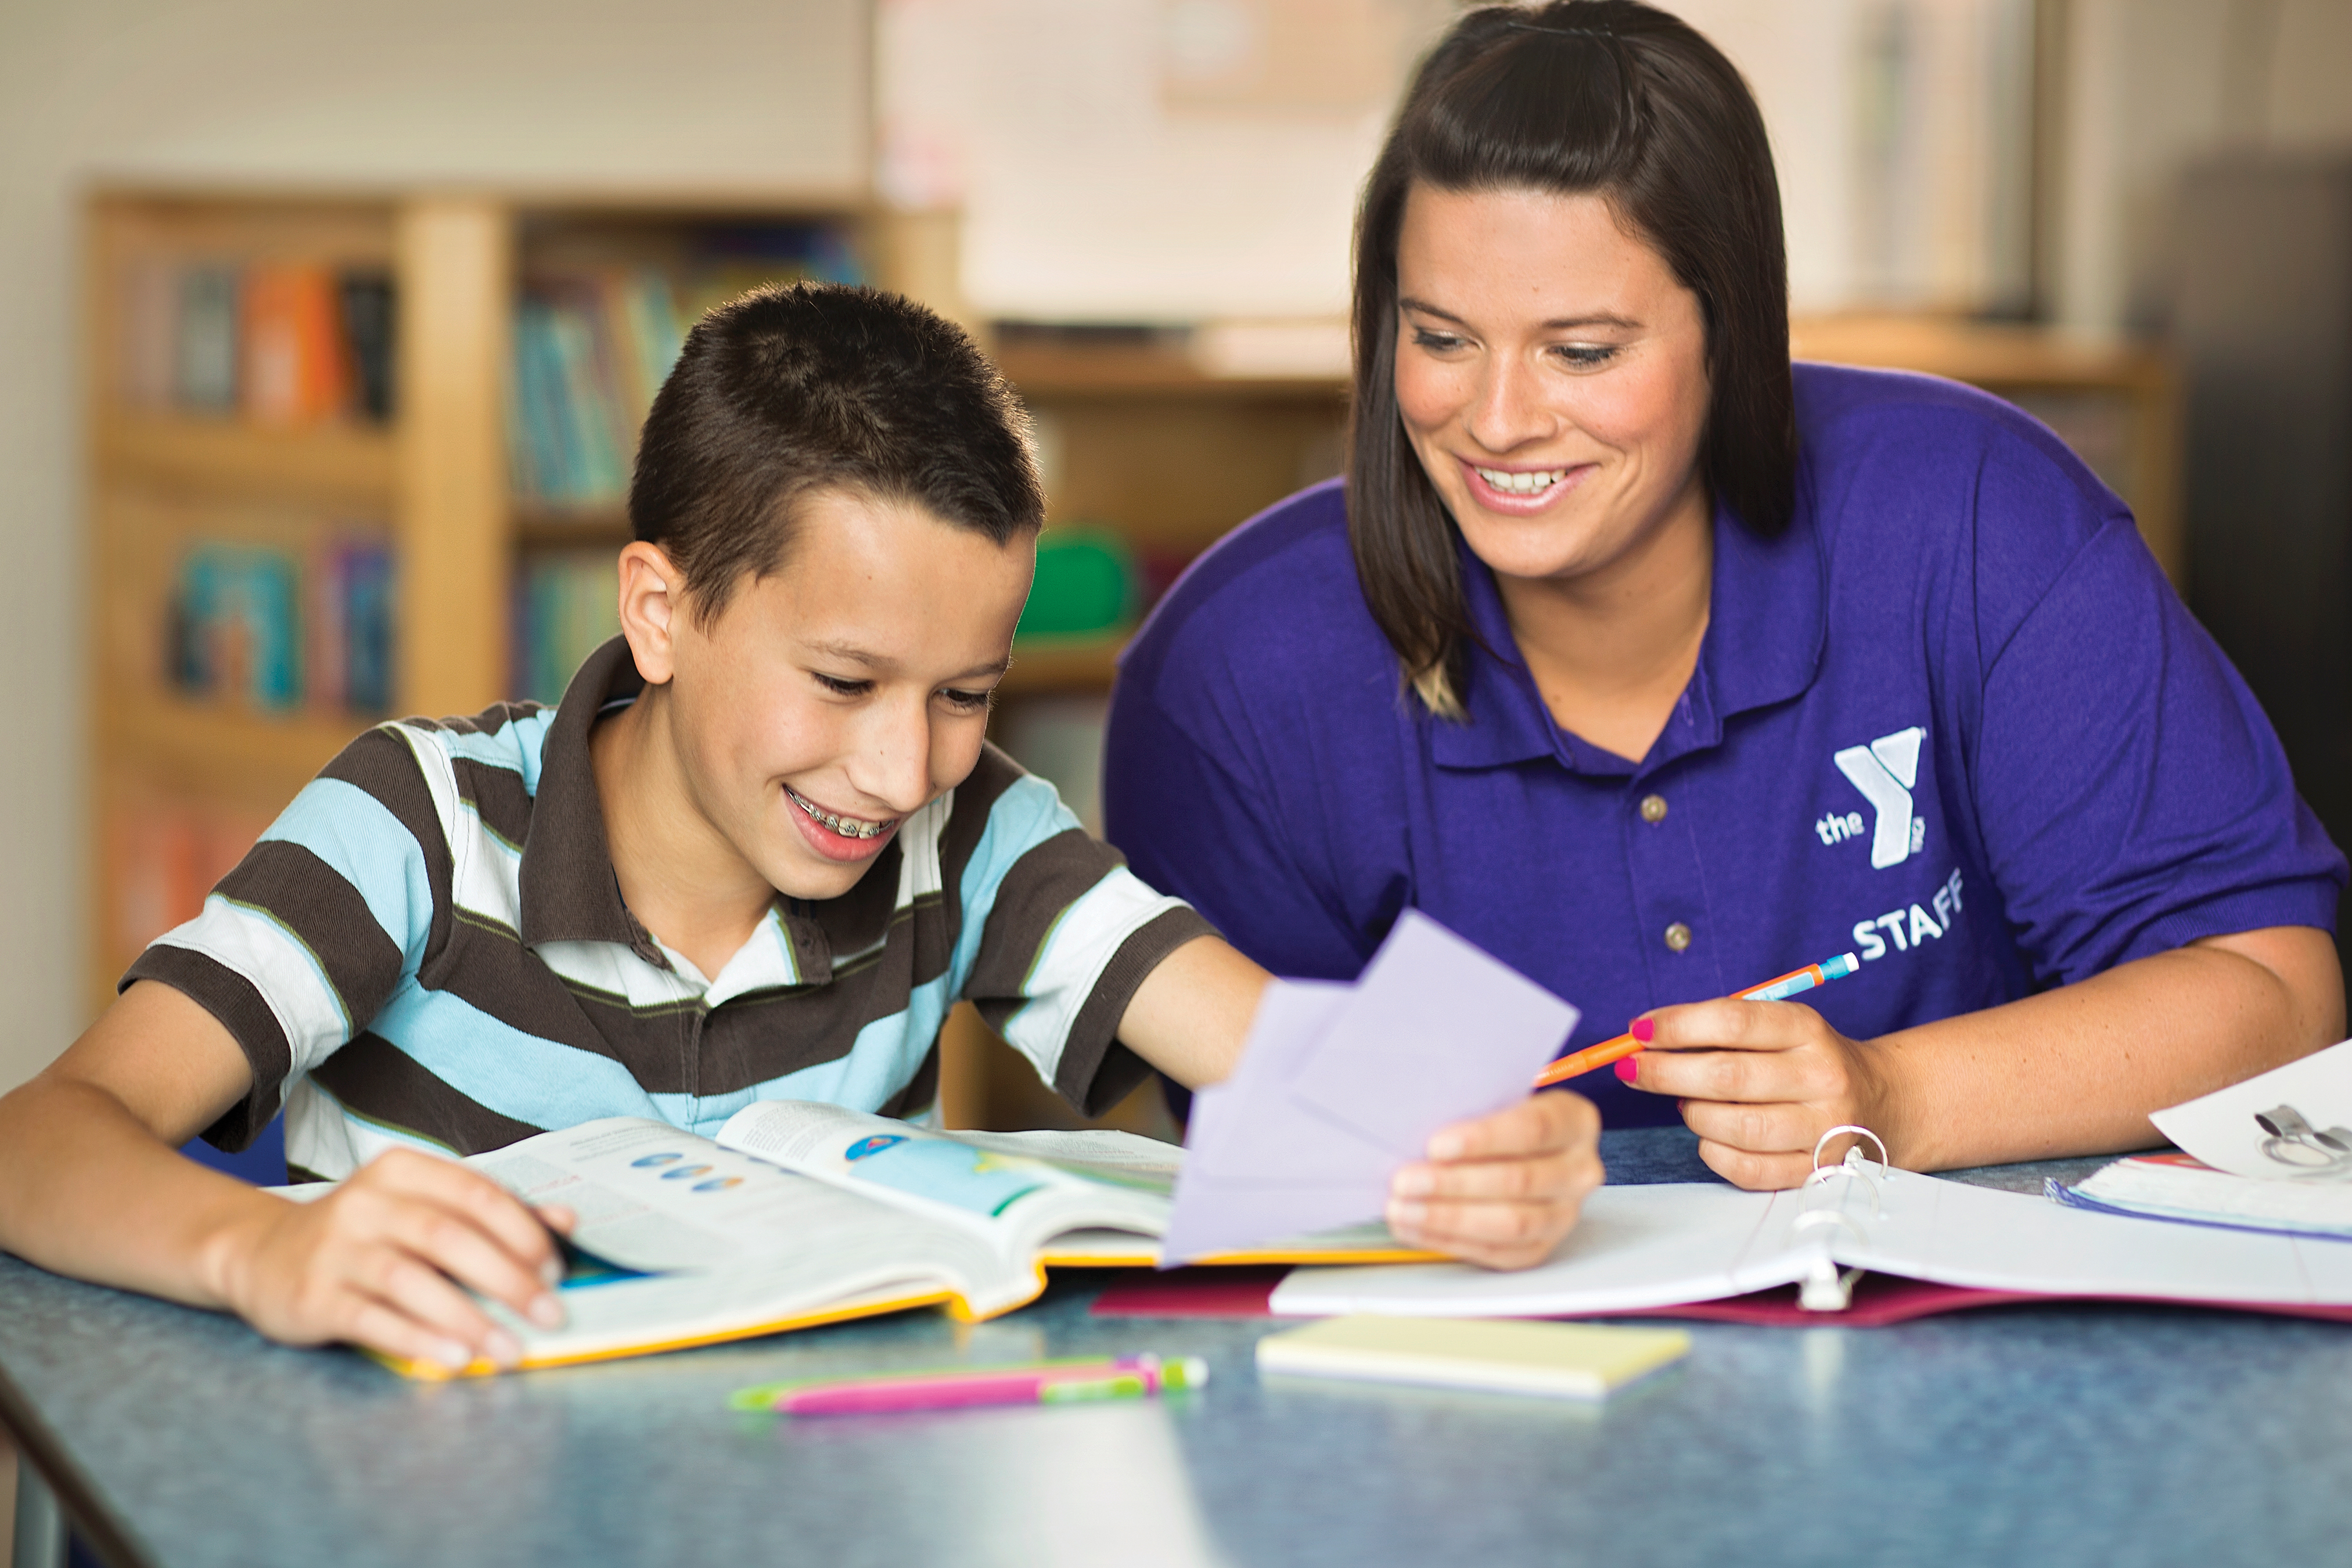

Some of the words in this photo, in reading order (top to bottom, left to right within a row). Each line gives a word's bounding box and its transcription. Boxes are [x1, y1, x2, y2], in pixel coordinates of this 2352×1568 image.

[1815, 811, 1865, 846] the
[1833, 726, 1922, 869] Y
[1853, 867, 1963, 961] STAFF
